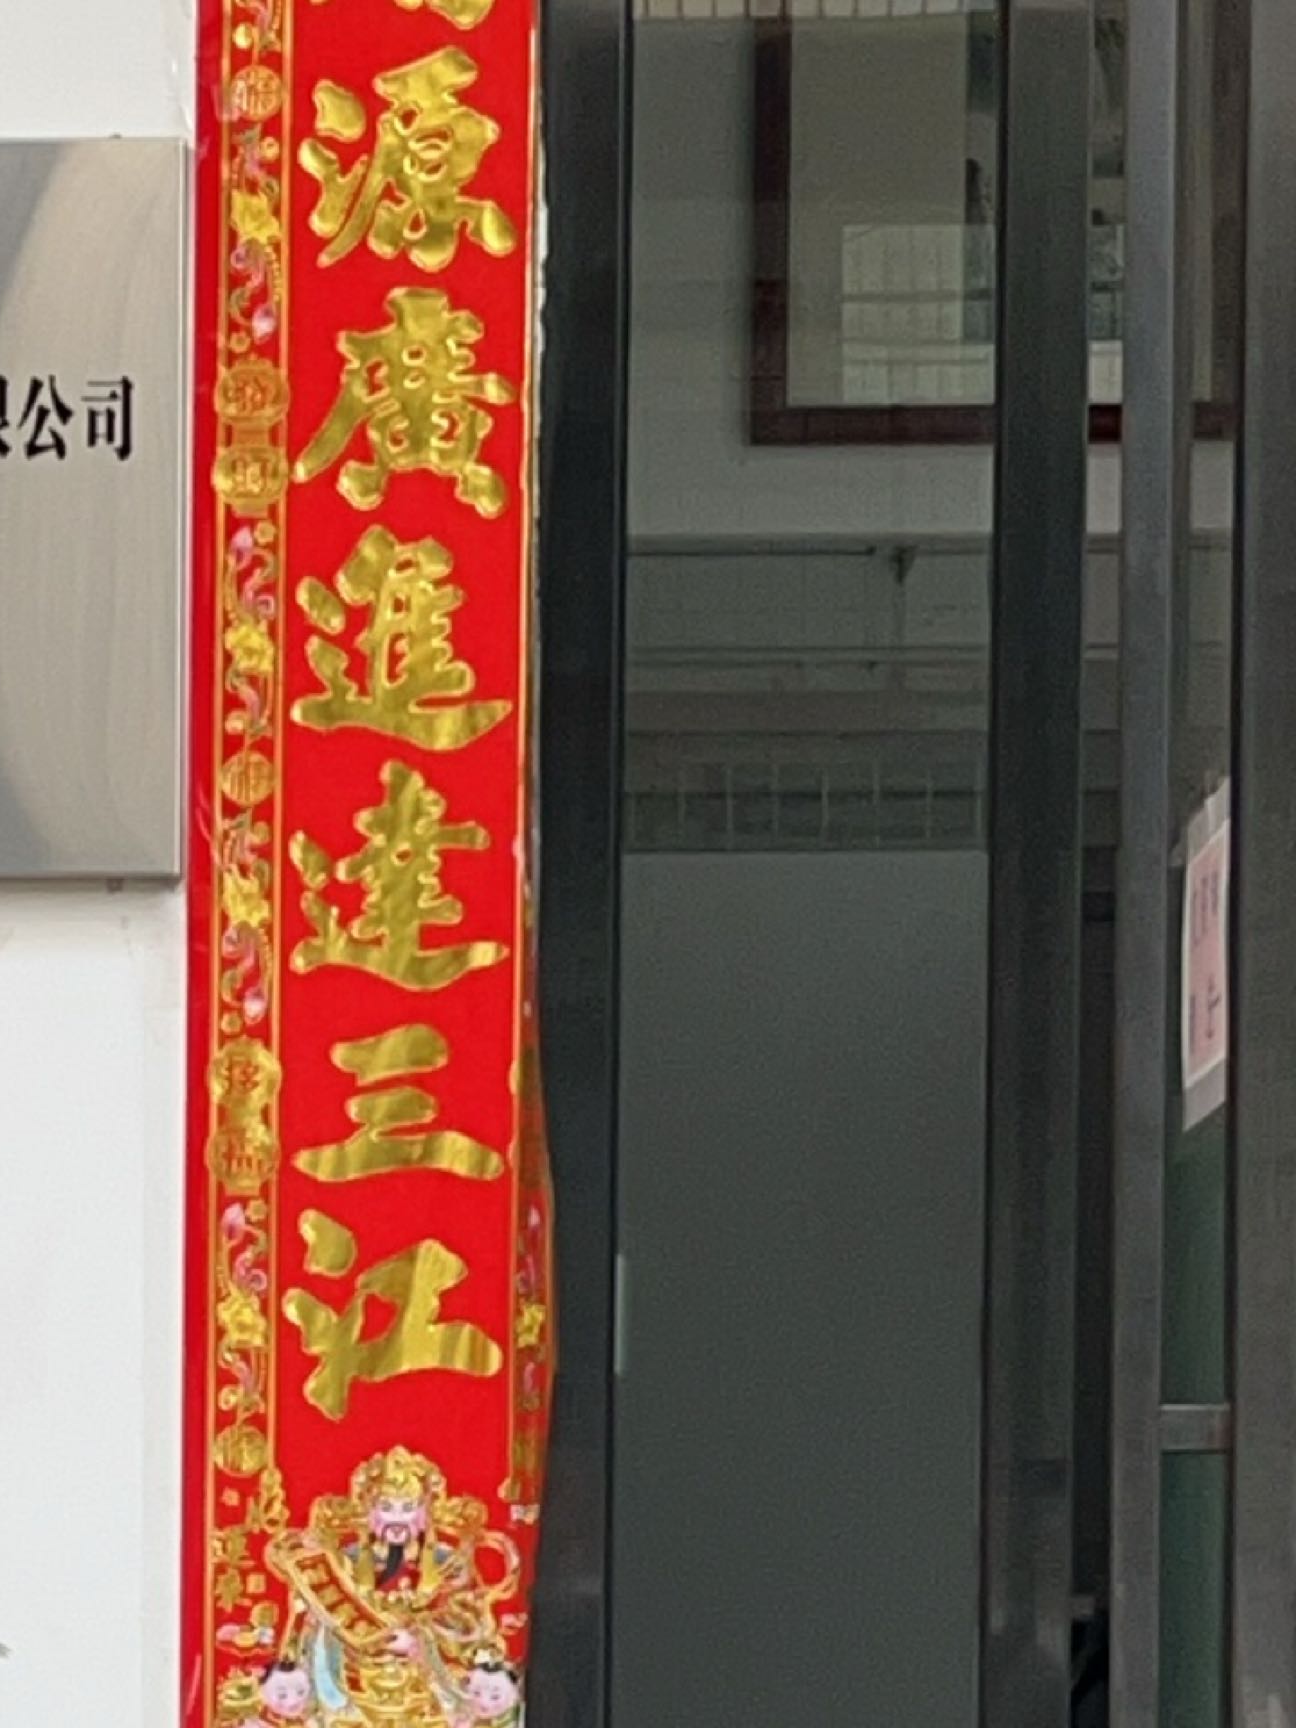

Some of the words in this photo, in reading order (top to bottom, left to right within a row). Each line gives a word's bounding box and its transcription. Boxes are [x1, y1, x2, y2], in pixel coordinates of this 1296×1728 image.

[281, 0, 516, 1421] 源廣進達三江
